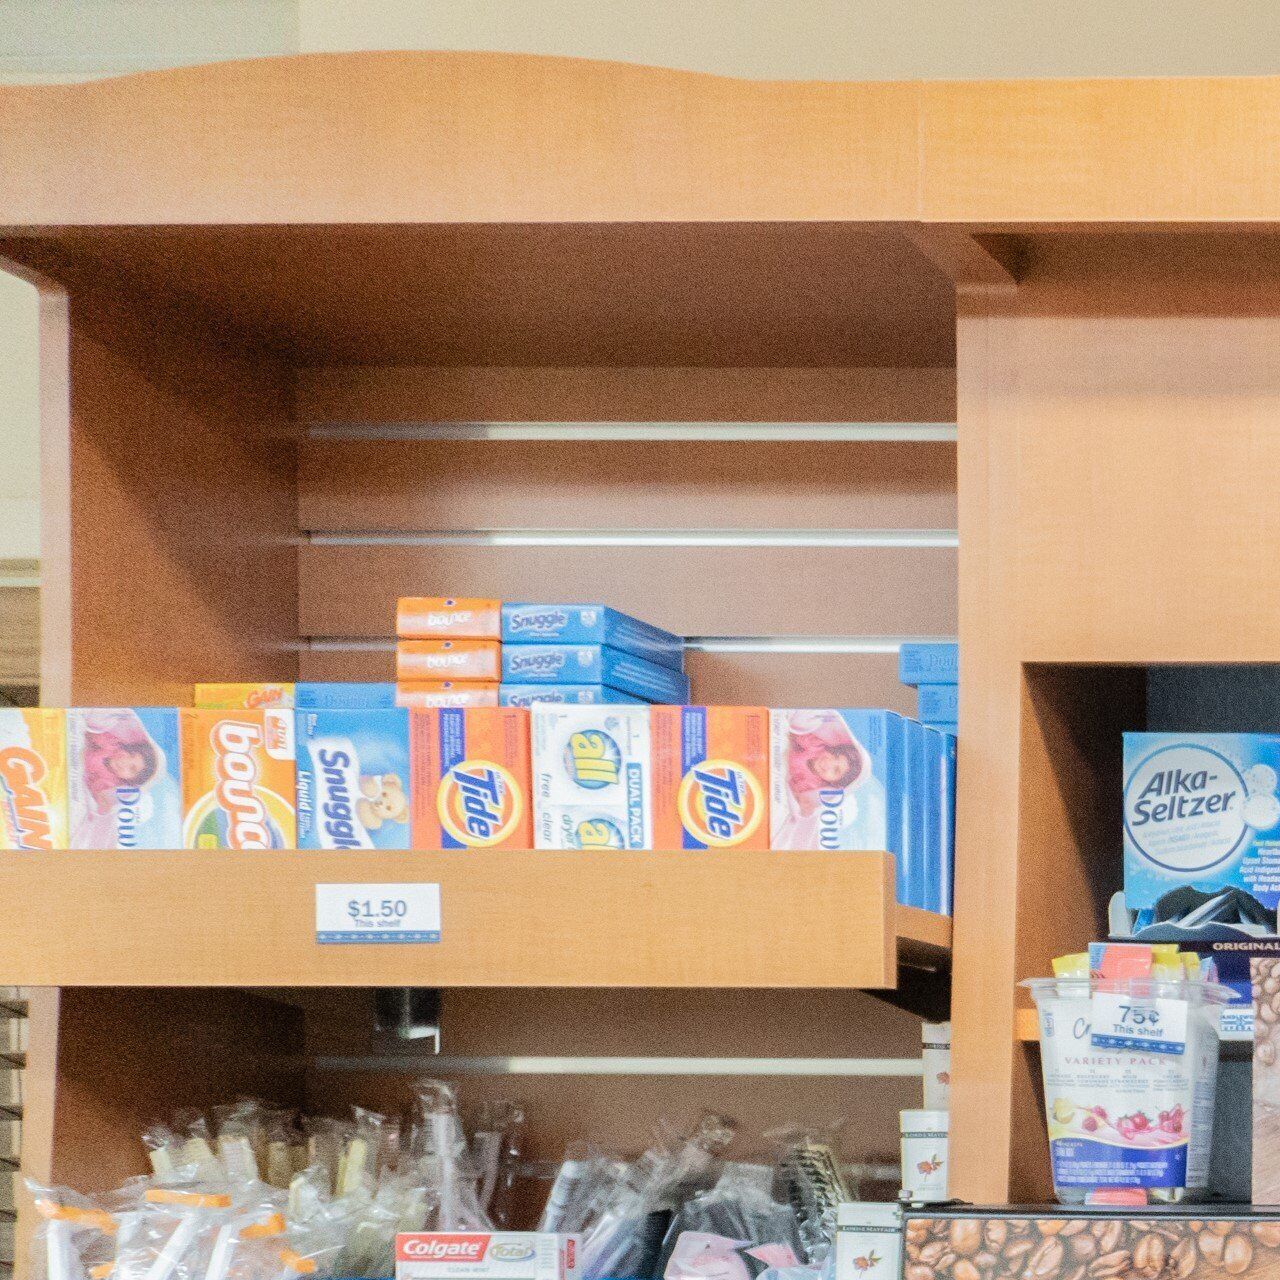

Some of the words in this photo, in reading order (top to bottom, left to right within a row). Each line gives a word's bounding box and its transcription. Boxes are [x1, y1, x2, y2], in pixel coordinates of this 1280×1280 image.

[570, 733, 621, 785] all
[1138, 769, 1218, 800] Alka-
[451, 768, 499, 839] Tide
[693, 768, 743, 840] Tide
[1132, 791, 1236, 827] Seltzer
[347, 899, 407, 918] $1.50
[1118, 1005, 1160, 1025] 75¢
[402, 1240, 481, 1258] Colgate
[490, 1243, 535, 1260] Total
